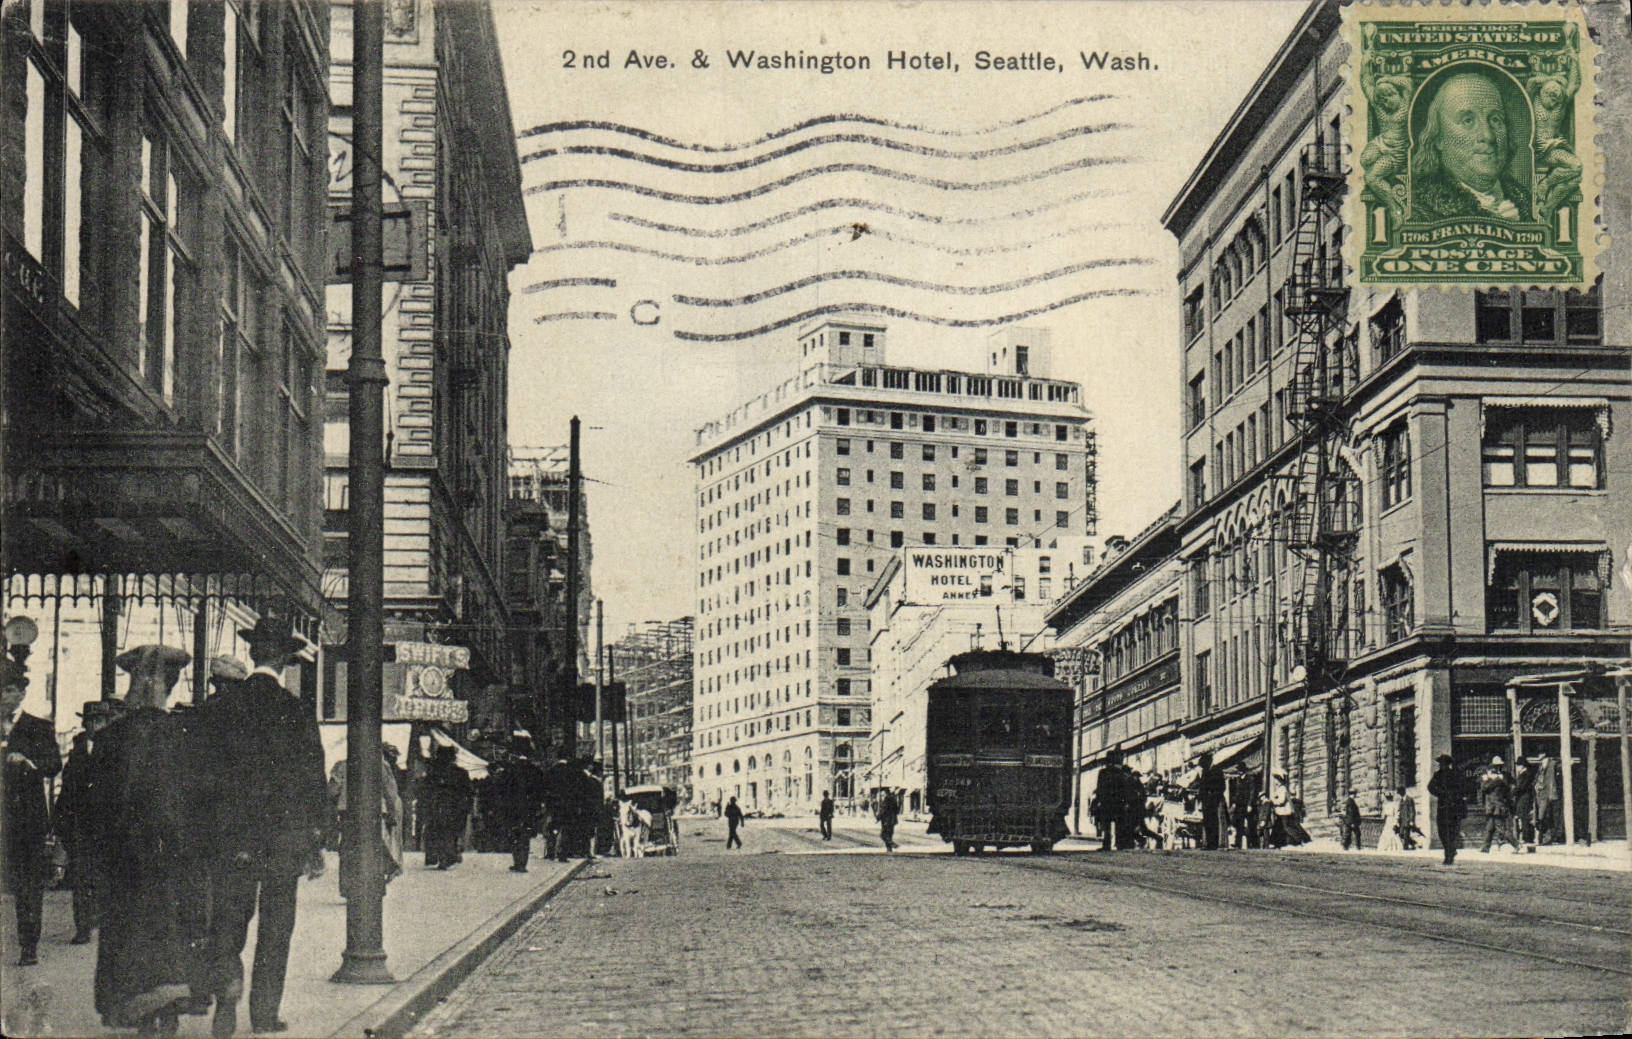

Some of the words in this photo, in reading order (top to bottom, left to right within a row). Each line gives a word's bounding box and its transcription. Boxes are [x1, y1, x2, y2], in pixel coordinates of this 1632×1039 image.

[1379, 32, 1453, 44] UNITED
[1455, 32, 1532, 44] STATES
[1533, 32, 1562, 44] OF
[1420, 49, 1527, 68] AMERICA
[1372, 206, 1388, 243] 1
[1556, 206, 1572, 243] 1
[1401, 231, 1431, 244] 1706
[1432, 223, 1515, 243] FRANKLIN
[1515, 231, 1543, 244] 1790
[1410, 248, 1534, 260] POSTAGE
[1382, 260, 1460, 273] ONE
[1464, 260, 1562, 273] CENT
[912, 553, 1005, 569] WASHINGTON
[930, 574, 973, 586] HOTEL
